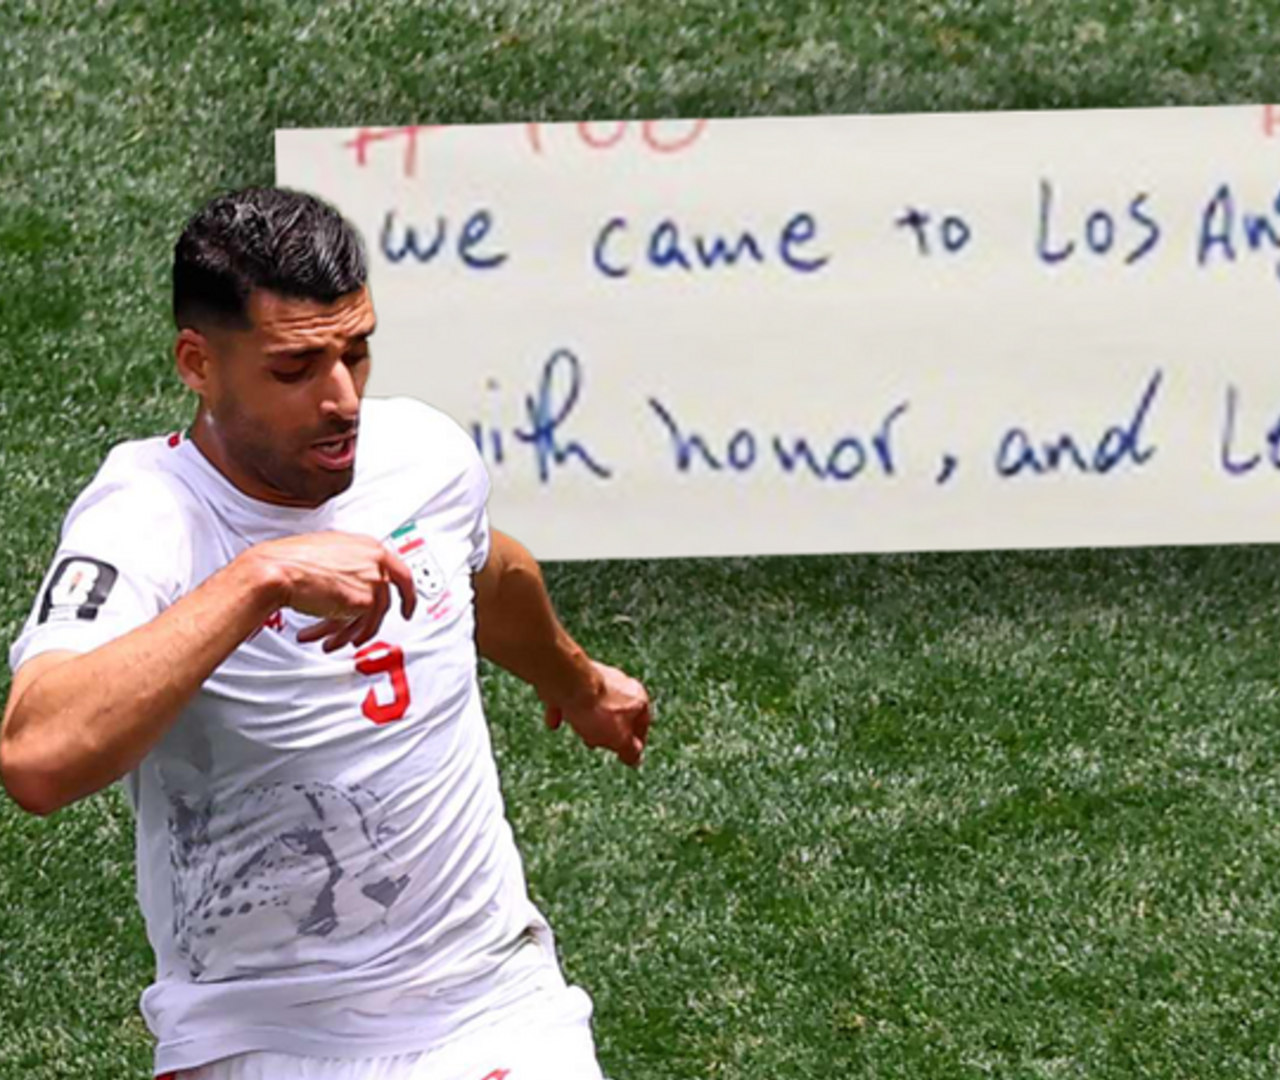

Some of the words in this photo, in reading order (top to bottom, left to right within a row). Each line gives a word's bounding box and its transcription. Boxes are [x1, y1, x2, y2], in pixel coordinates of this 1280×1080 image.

[380, 210, 509, 270] we
[593, 212, 828, 279] came
[895, 207, 972, 256] to
[1038, 180, 1160, 265] Los
[472, 349, 611, 484] ith
[995, 369, 1162, 478] and
